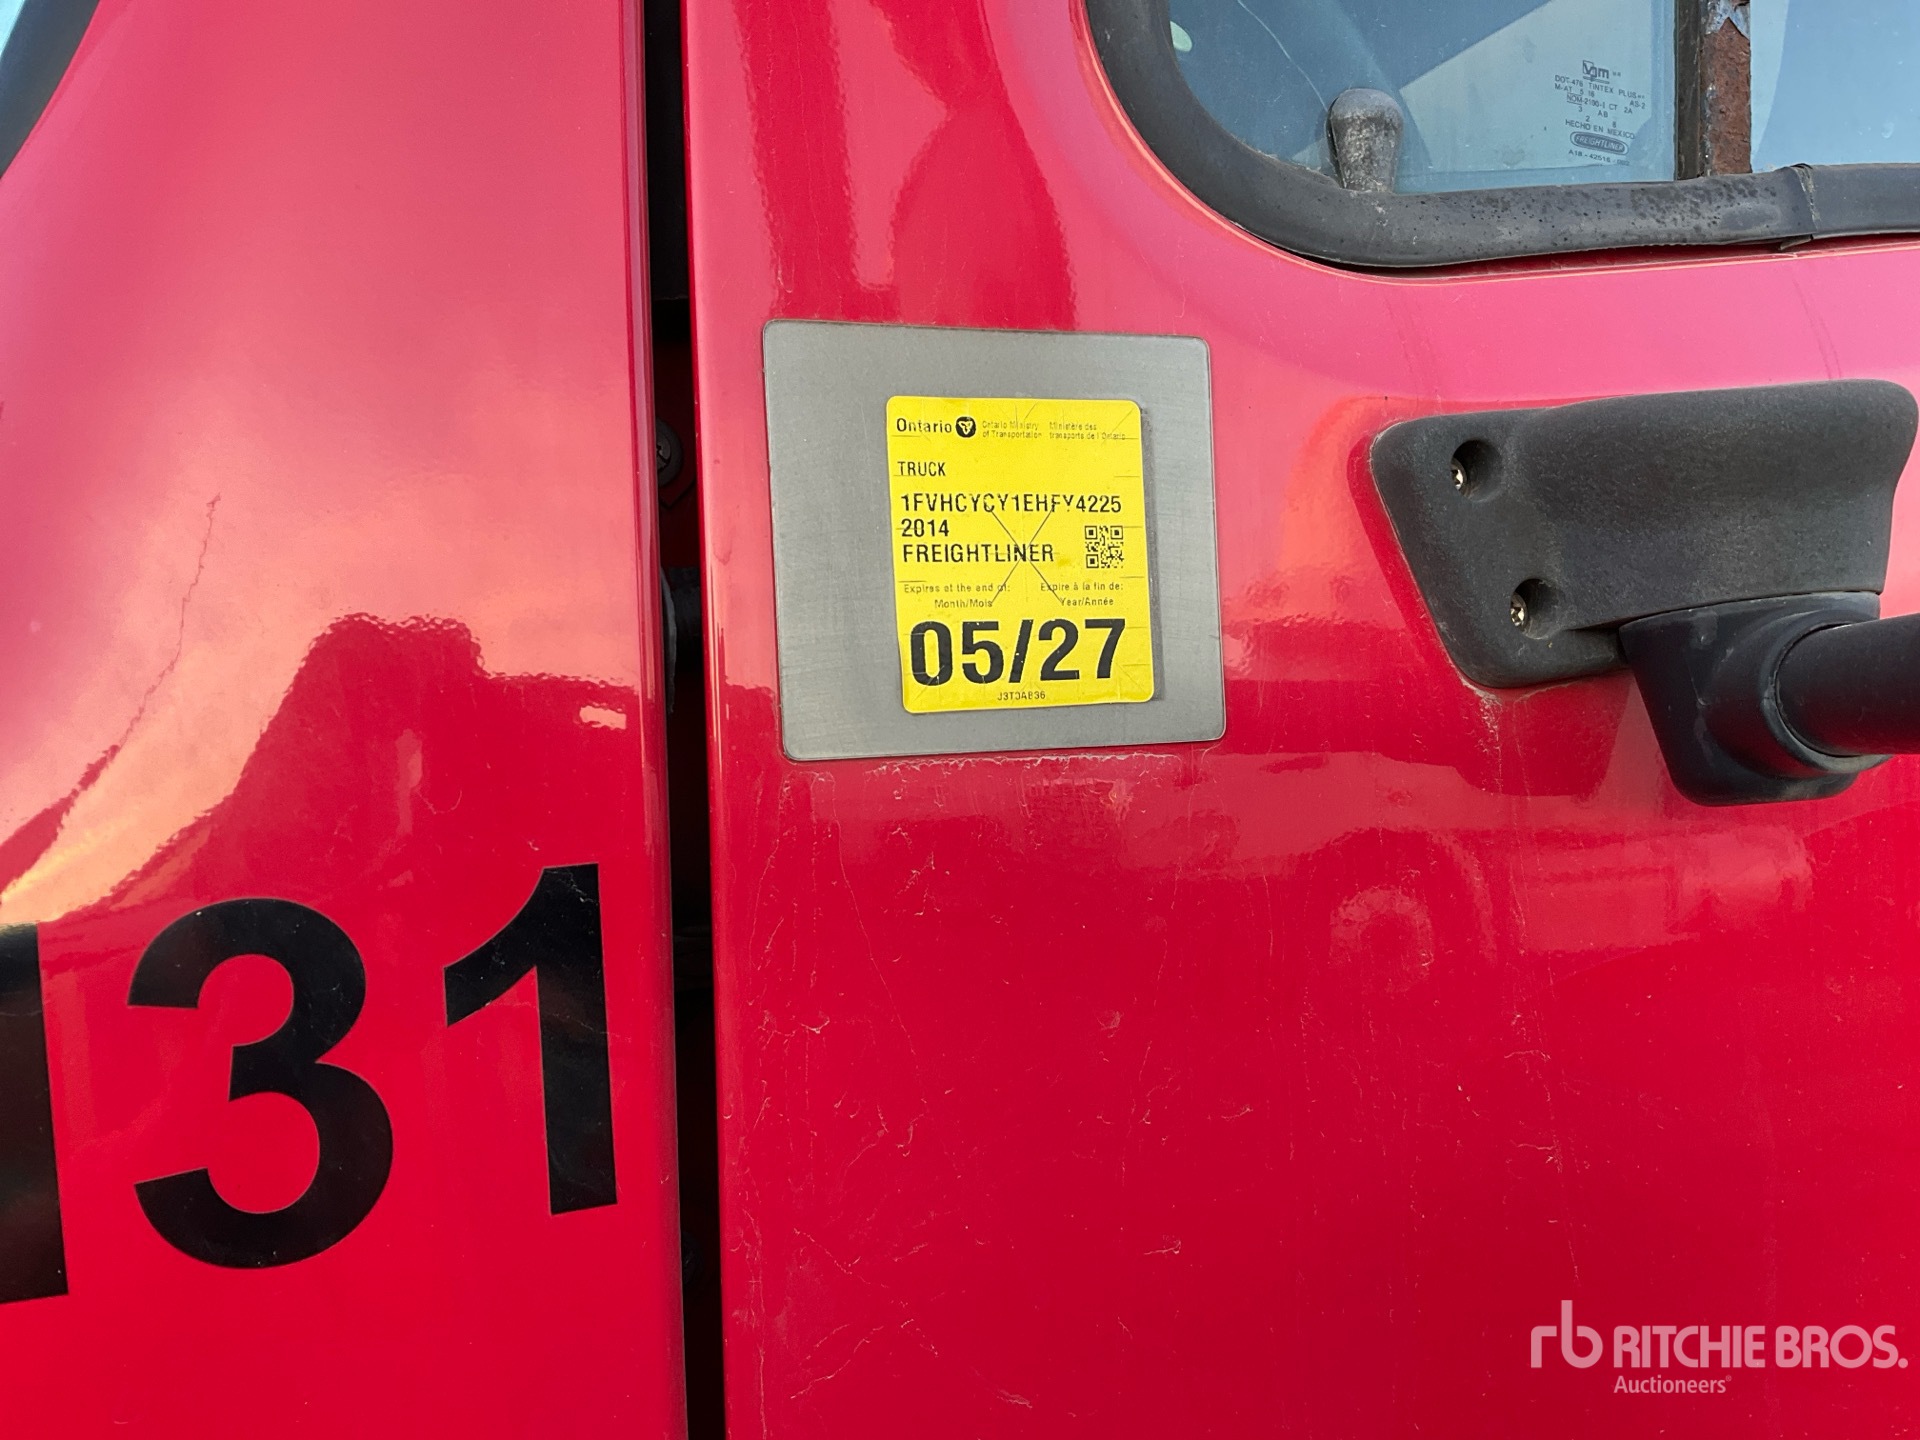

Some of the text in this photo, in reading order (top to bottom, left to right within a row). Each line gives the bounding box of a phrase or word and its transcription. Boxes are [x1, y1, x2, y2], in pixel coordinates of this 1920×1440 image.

[1588, 82, 1614, 94] TINTEX
[1618, 89, 1637, 99] PLUS
[1629, 100, 1646, 109] AS-2
[1565, 119, 1635, 139] HECHO EN MEXICO
[1575, 135, 1624, 151] FREIGHTLINER
[897, 418, 952, 433] Ontario
[982, 430, 1042, 439] of Transportation
[1049, 431, 1084, 440] transports
[1087, 431, 1095, 439] de
[897, 461, 946, 476] TRUCK
[901, 518, 949, 537] 2014
[903, 543, 1054, 562] FREIGHTLINER
[904, 584, 940, 594] Expires
[944, 584, 953, 592] at
[956, 584, 972, 592] the
[975, 583, 994, 592] end
[1040, 582, 1124, 592] Expire à la fin de:
[934, 599, 993, 608] Month/Mois
[1060, 597, 1114, 606] Year/Année
[910, 618, 1126, 686] 05/27
